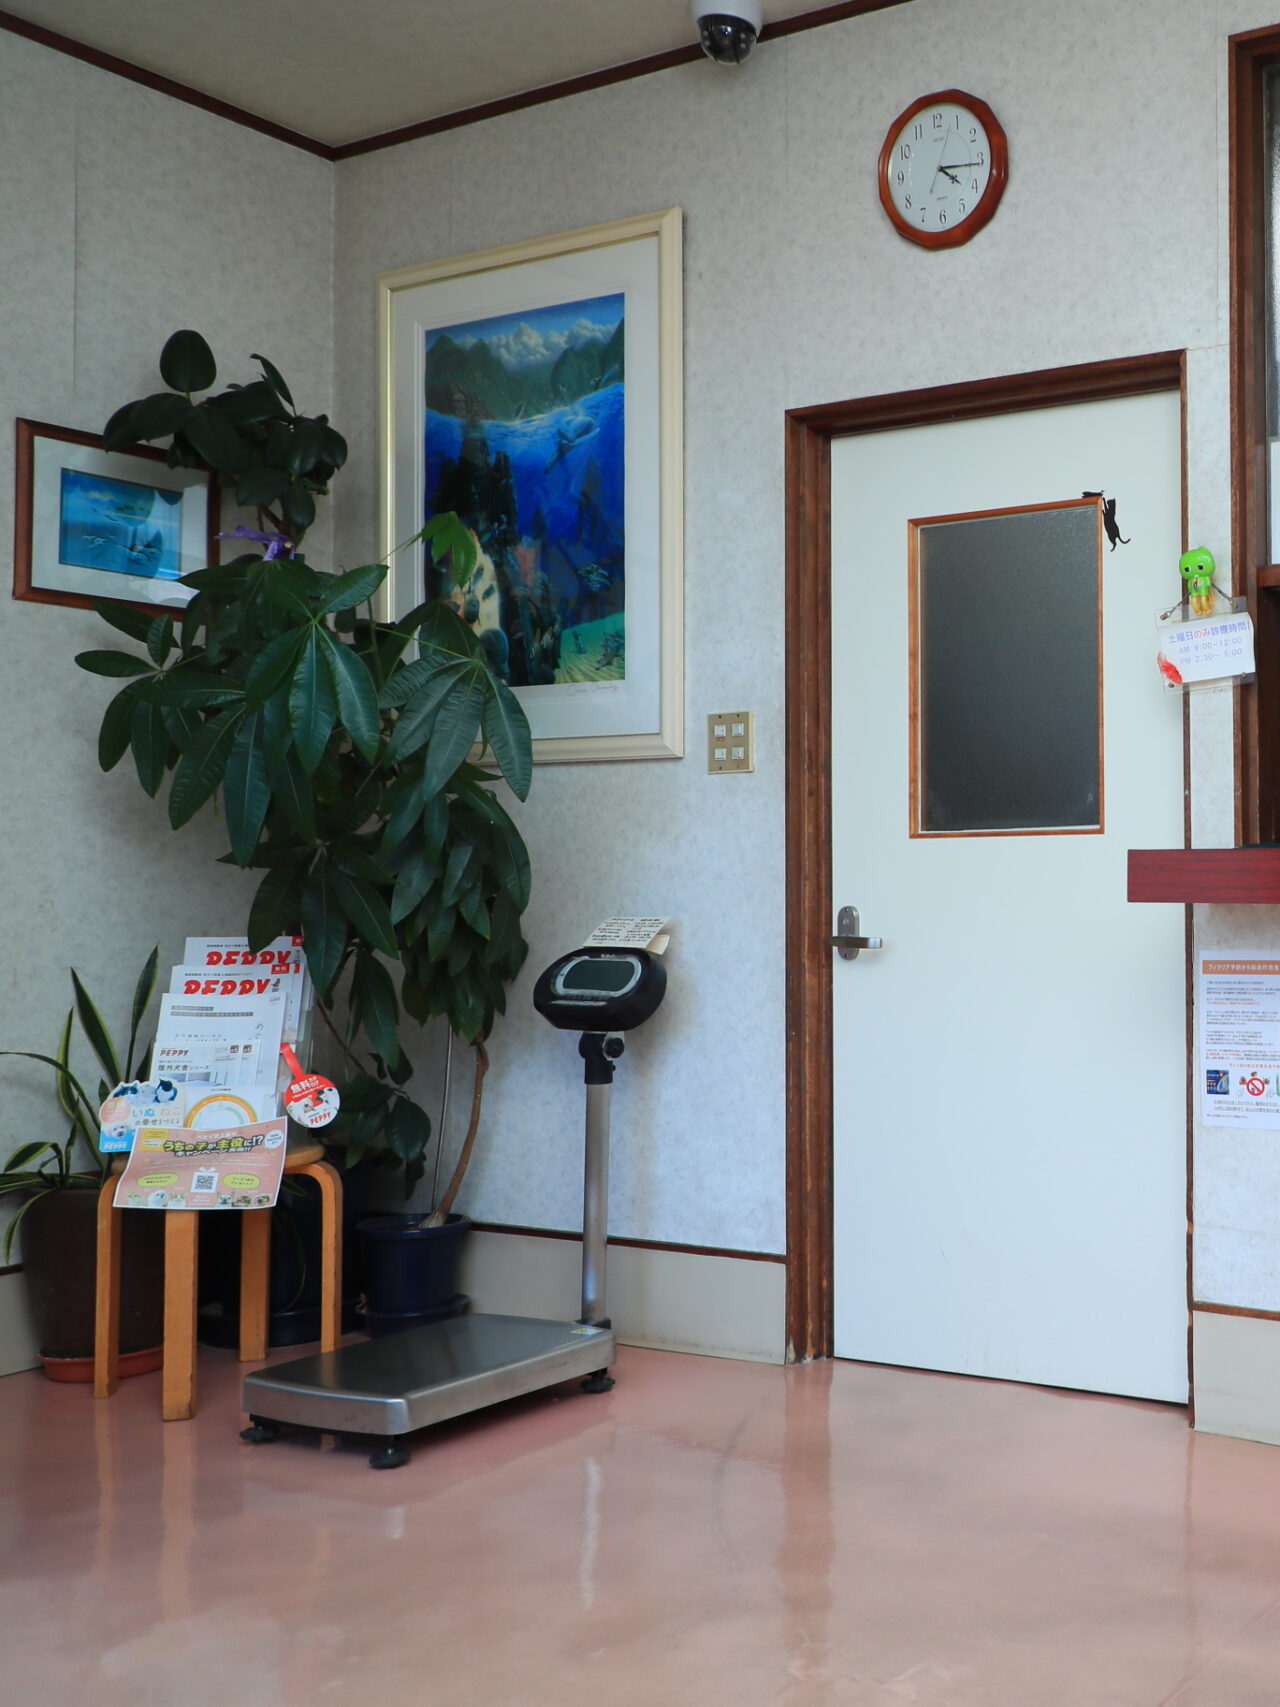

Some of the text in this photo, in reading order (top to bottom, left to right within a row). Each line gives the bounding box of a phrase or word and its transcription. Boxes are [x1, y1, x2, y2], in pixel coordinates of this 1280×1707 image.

[932, 113, 942, 128] 12
[914, 124, 923, 140] 11
[969, 128, 977, 142] 2
[900, 144, 911, 160] 10
[897, 171, 904, 185] 9
[971, 179, 978, 193] 4
[905, 195, 912, 209] 8
[958, 199, 965, 213] 5
[920, 207, 926, 223] 7
[939, 210, 947, 224] 6
[1168, 622, 1251, 644] 土曜日のみ診療時間
[310, 1112, 331, 1125] PEPPY
